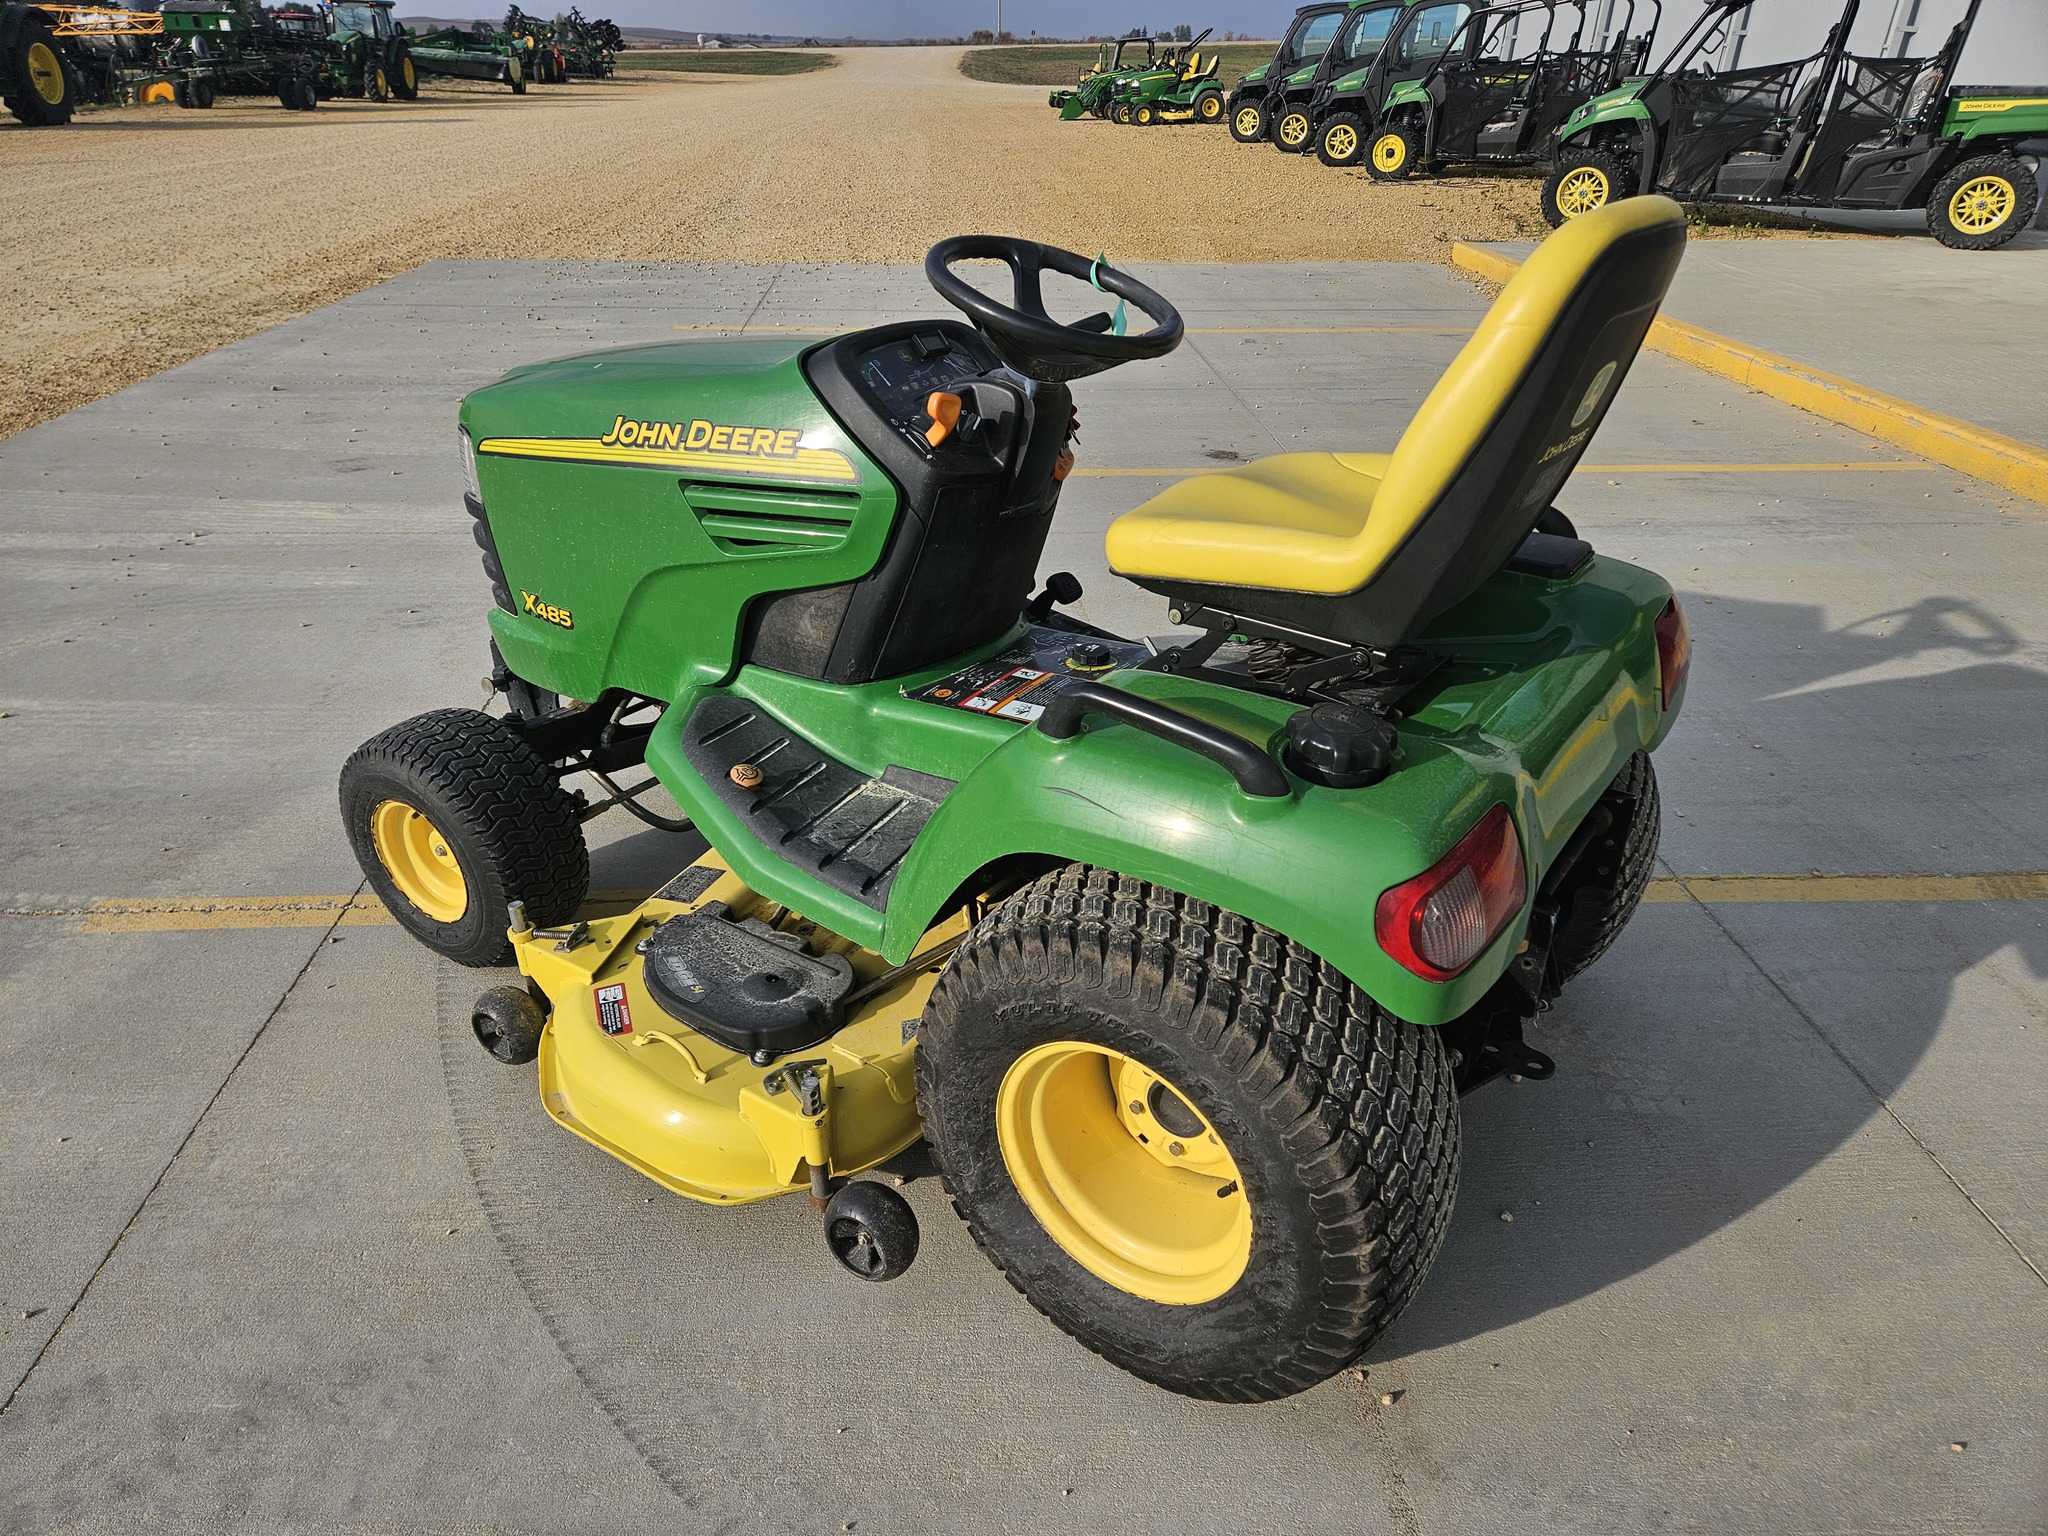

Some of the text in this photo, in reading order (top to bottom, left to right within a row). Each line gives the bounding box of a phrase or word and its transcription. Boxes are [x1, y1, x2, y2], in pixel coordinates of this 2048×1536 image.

[601, 415, 801, 456] JOHN DEERE
[520, 589, 573, 629] X485
